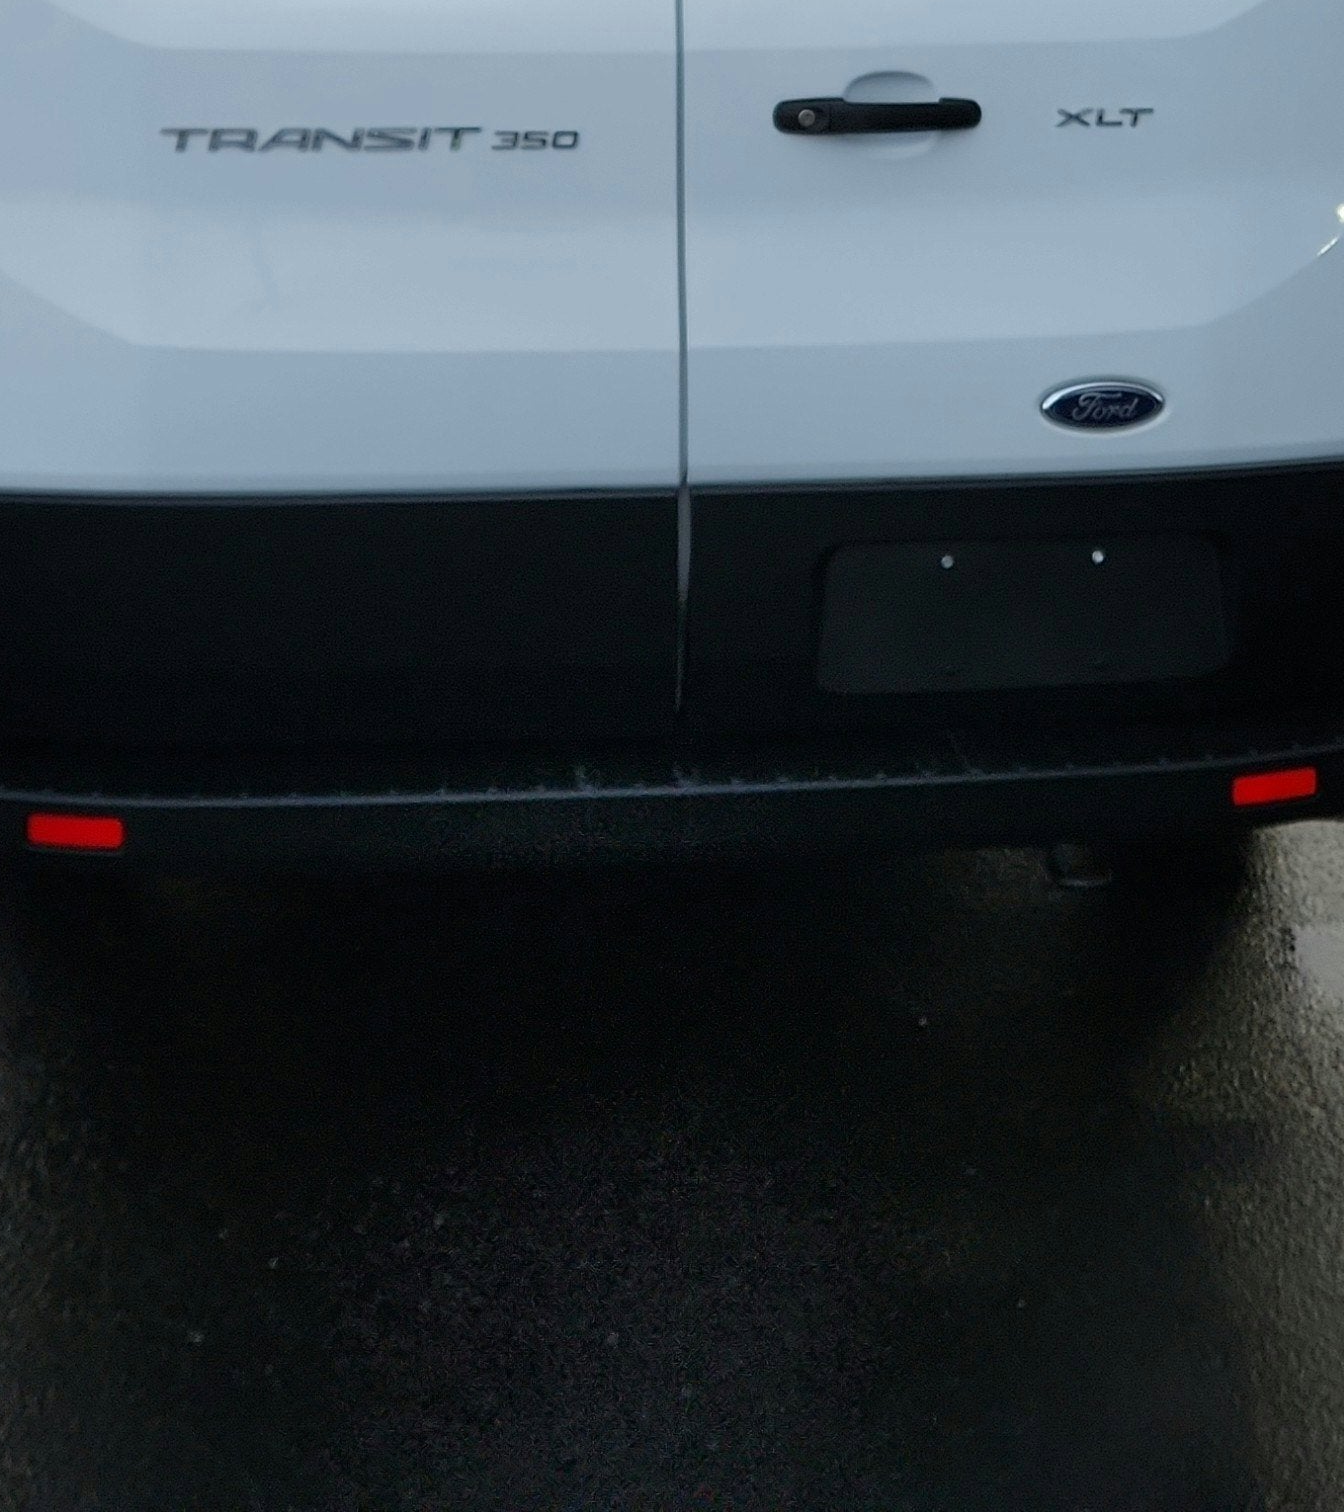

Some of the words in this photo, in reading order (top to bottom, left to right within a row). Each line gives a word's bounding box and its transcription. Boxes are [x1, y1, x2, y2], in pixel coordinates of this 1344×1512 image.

[1056, 107, 1154, 128] XLT
[160, 127, 482, 153] TRANSIT
[491, 130, 579, 151] 350
[1071, 392, 1139, 421] Ford
